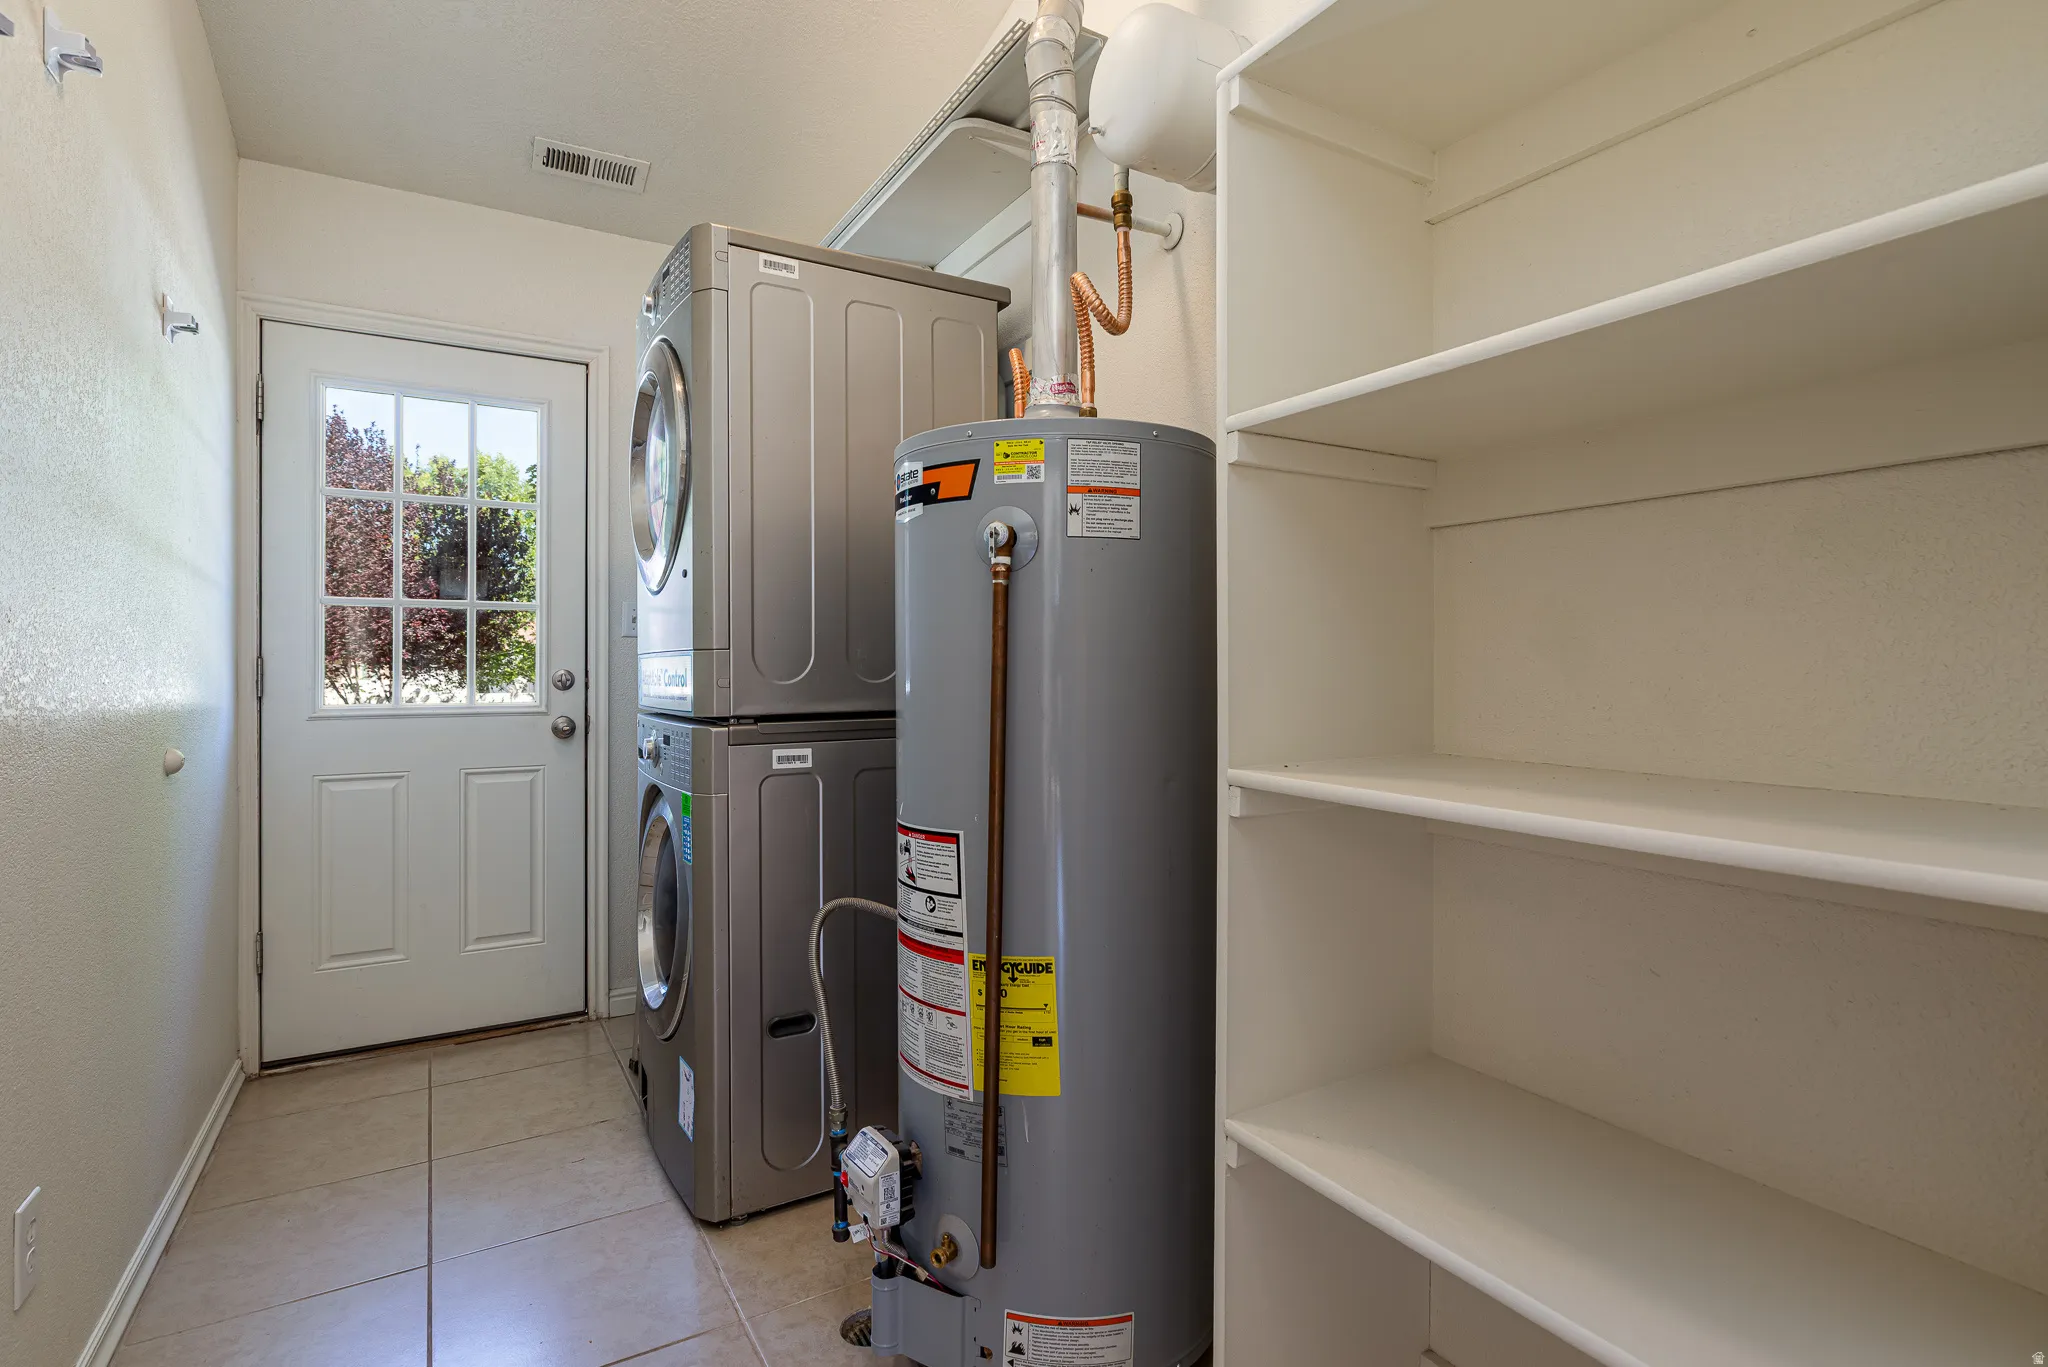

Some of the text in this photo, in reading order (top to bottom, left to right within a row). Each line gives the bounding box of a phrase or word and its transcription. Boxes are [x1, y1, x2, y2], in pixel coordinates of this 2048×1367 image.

[901, 469, 919, 483] state
[664, 668, 687, 687] Control
[972, 960, 1053, 974] ENGYGUIDE
